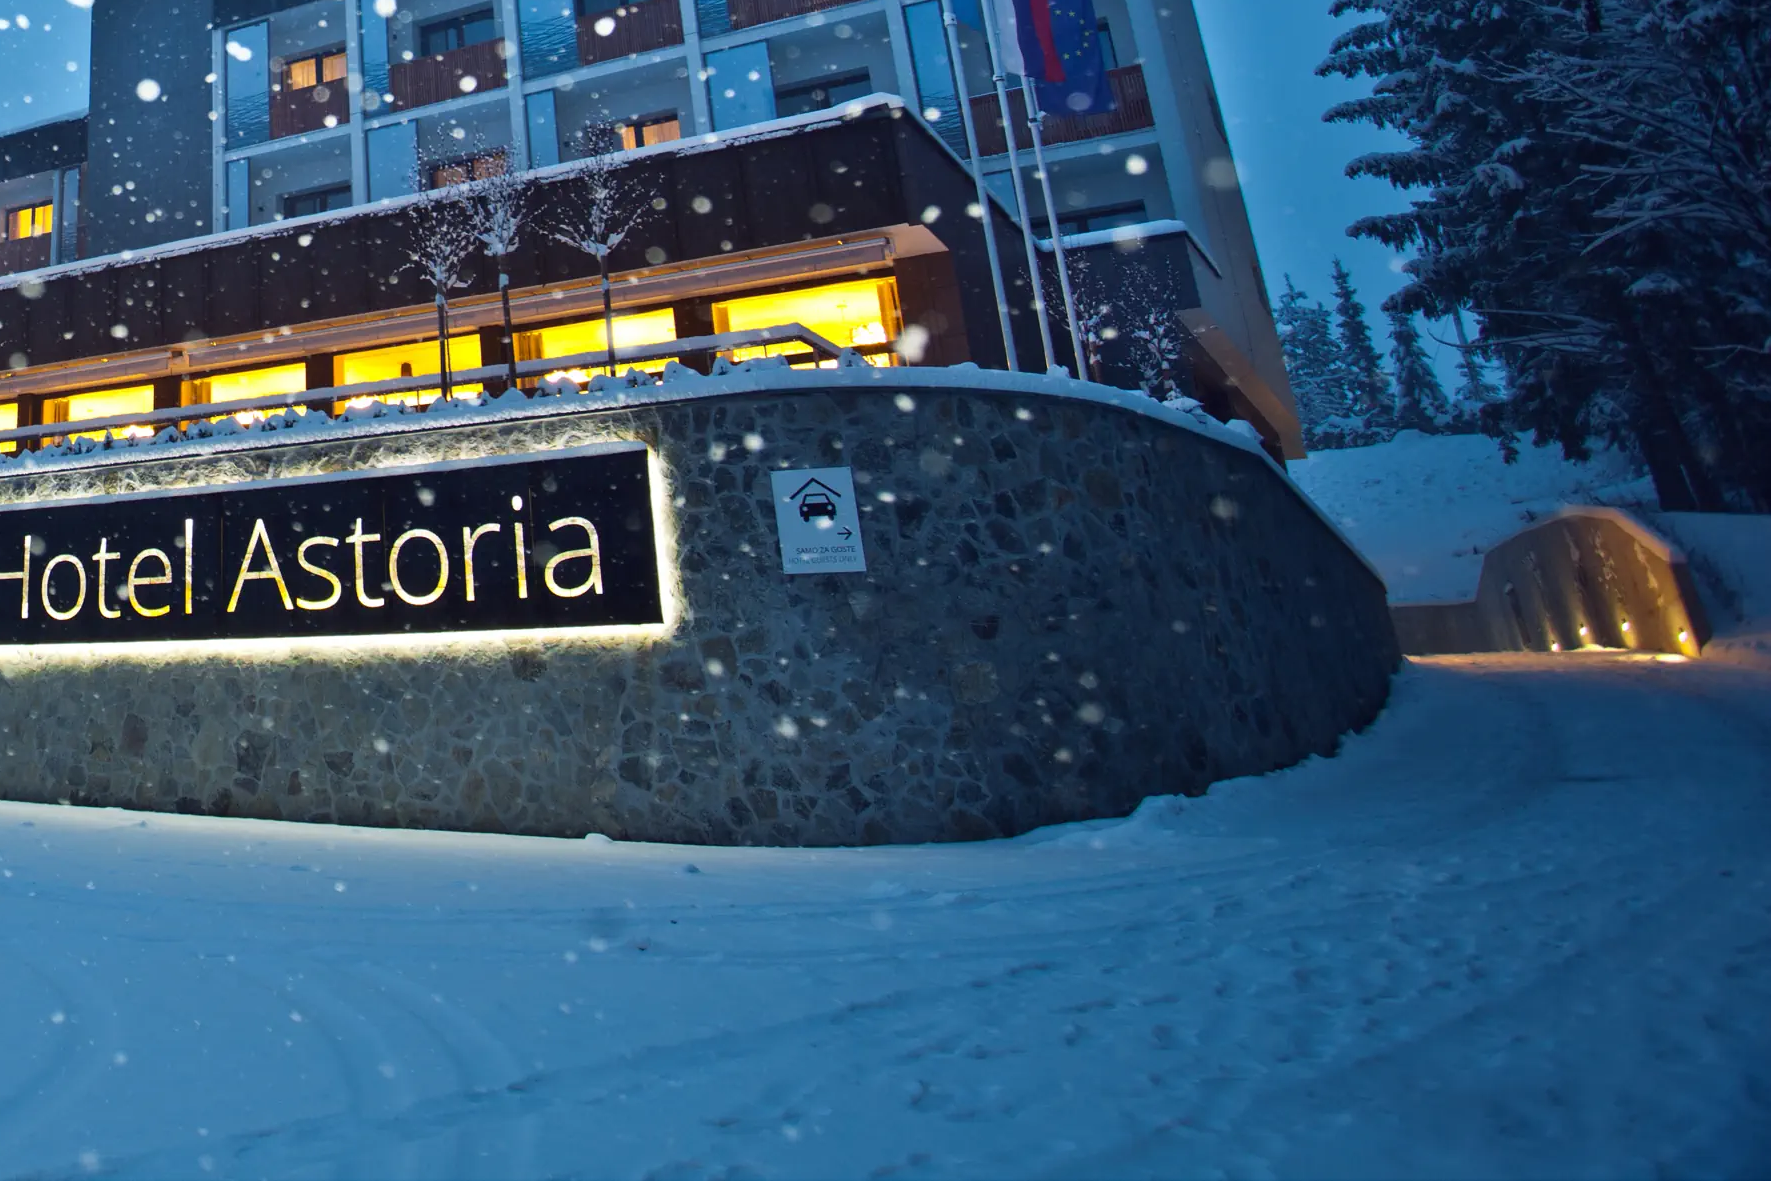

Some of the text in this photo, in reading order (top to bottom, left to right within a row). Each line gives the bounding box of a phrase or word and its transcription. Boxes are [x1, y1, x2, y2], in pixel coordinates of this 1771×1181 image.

[227, 495, 604, 613] Astoria
[796, 545, 857, 555] SAMO ZA GOSTE
